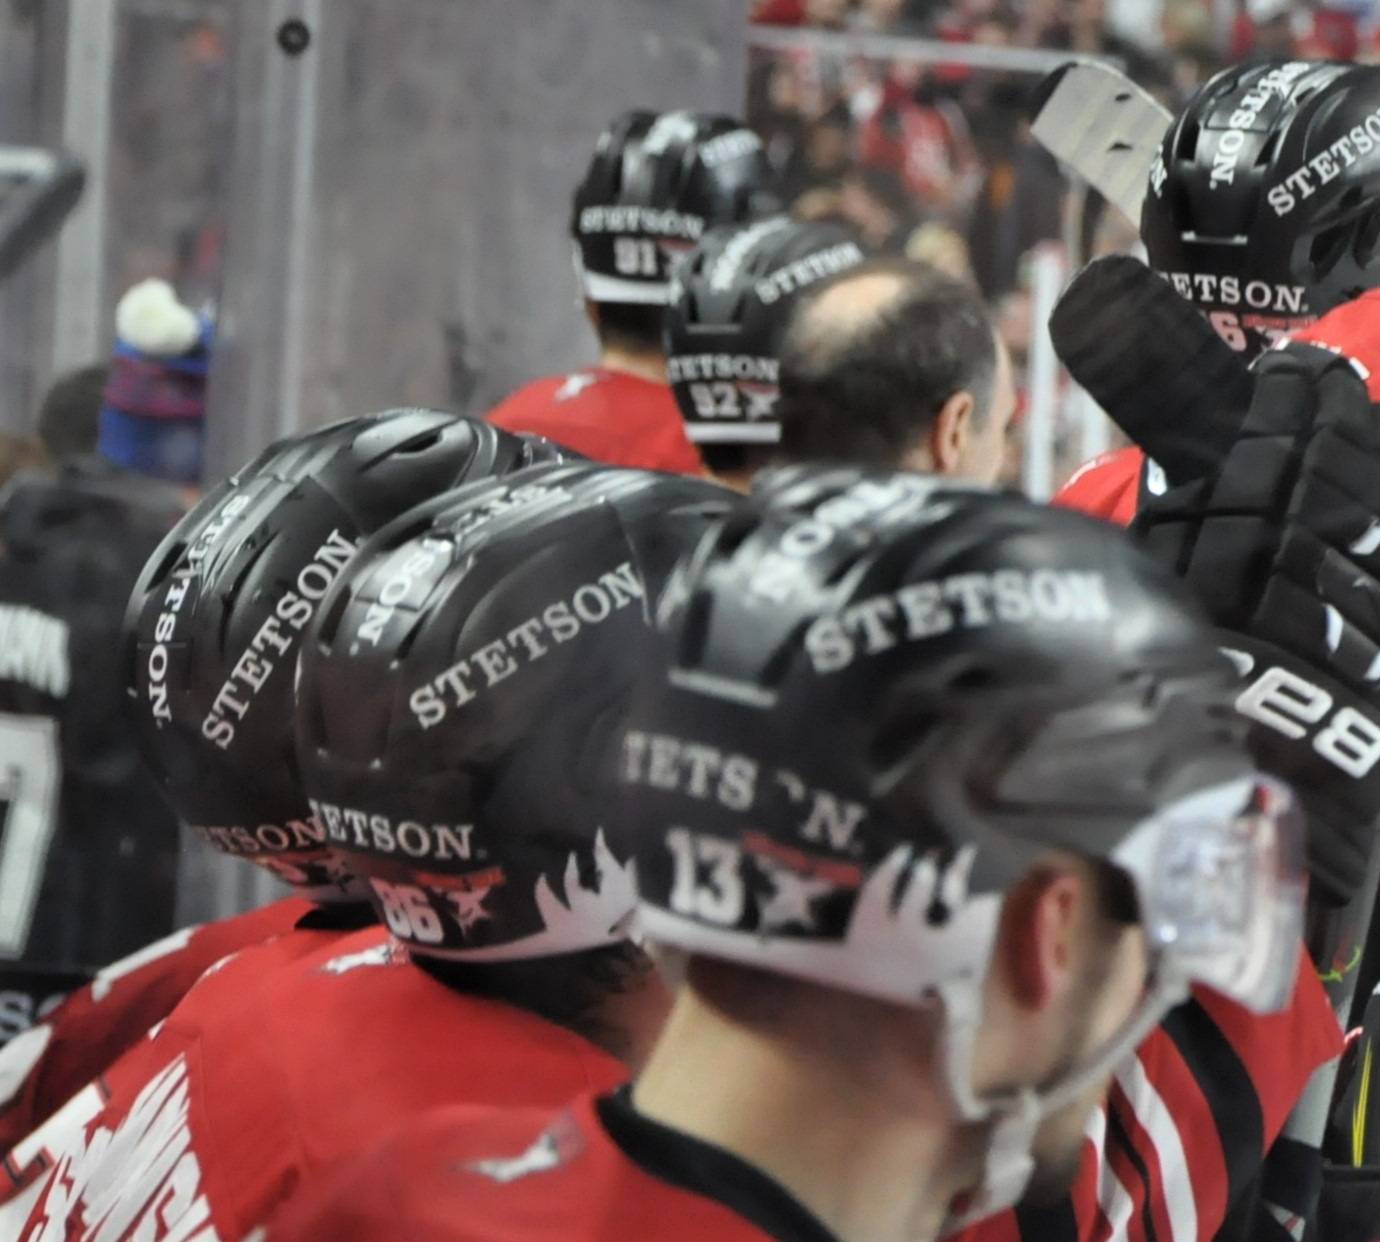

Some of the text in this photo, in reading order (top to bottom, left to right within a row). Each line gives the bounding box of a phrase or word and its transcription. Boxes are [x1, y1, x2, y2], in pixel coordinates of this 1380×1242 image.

[1160, 272, 1309, 313] ETSON
[201, 527, 363, 751] STETSON
[409, 561, 647, 729] STETSON
[803, 565, 1113, 674] STETSON
[665, 827, 744, 926] 13
